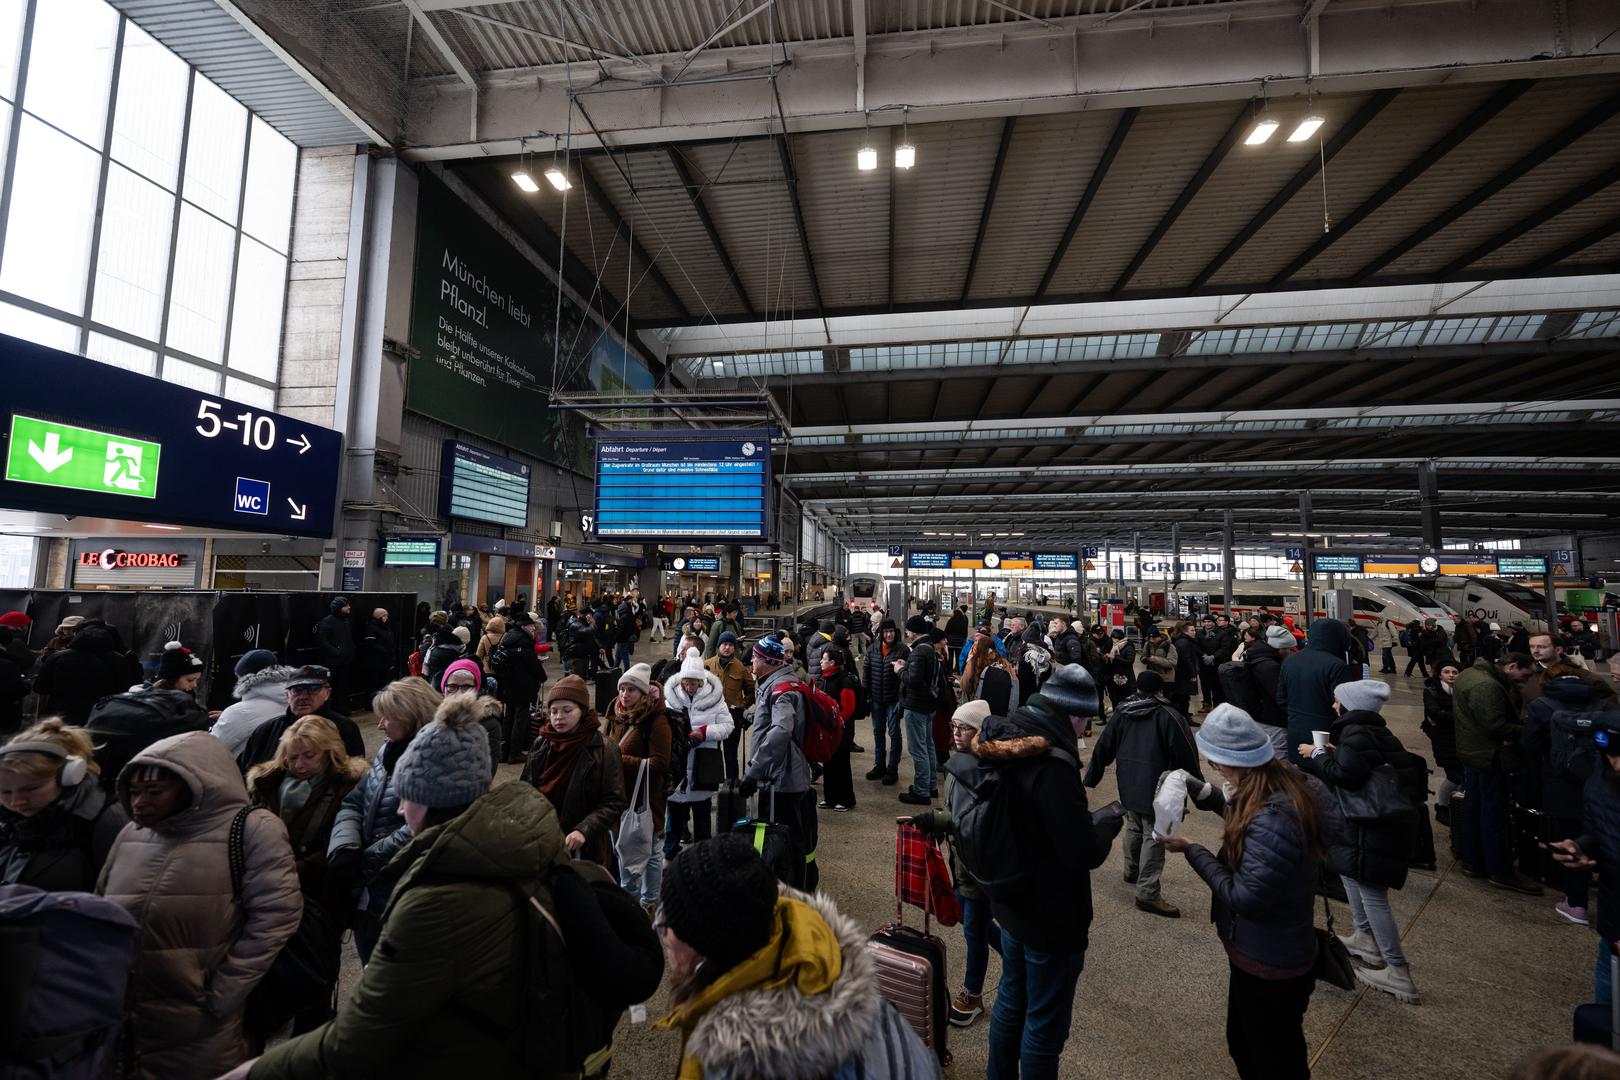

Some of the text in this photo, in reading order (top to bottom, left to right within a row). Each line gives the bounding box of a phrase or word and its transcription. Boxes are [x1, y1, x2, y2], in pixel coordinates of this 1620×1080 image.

[442, 248, 531, 328] München liebt
[440, 279, 489, 329] Pflanzl.
[438, 316, 453, 334] Die
[454, 325, 478, 348] Hälfte
[479, 344, 504, 362] unserer
[437, 332, 460, 356] bleibt
[462, 350, 496, 374] unberührt
[436, 354, 452, 370] und
[195, 398, 276, 452] 5-10
[238, 494, 262, 510] WC
[889, 546, 900, 555] 12
[1086, 548, 1097, 556] 13
[1289, 549, 1301, 558] 14
[1555, 551, 1568, 560] 15
